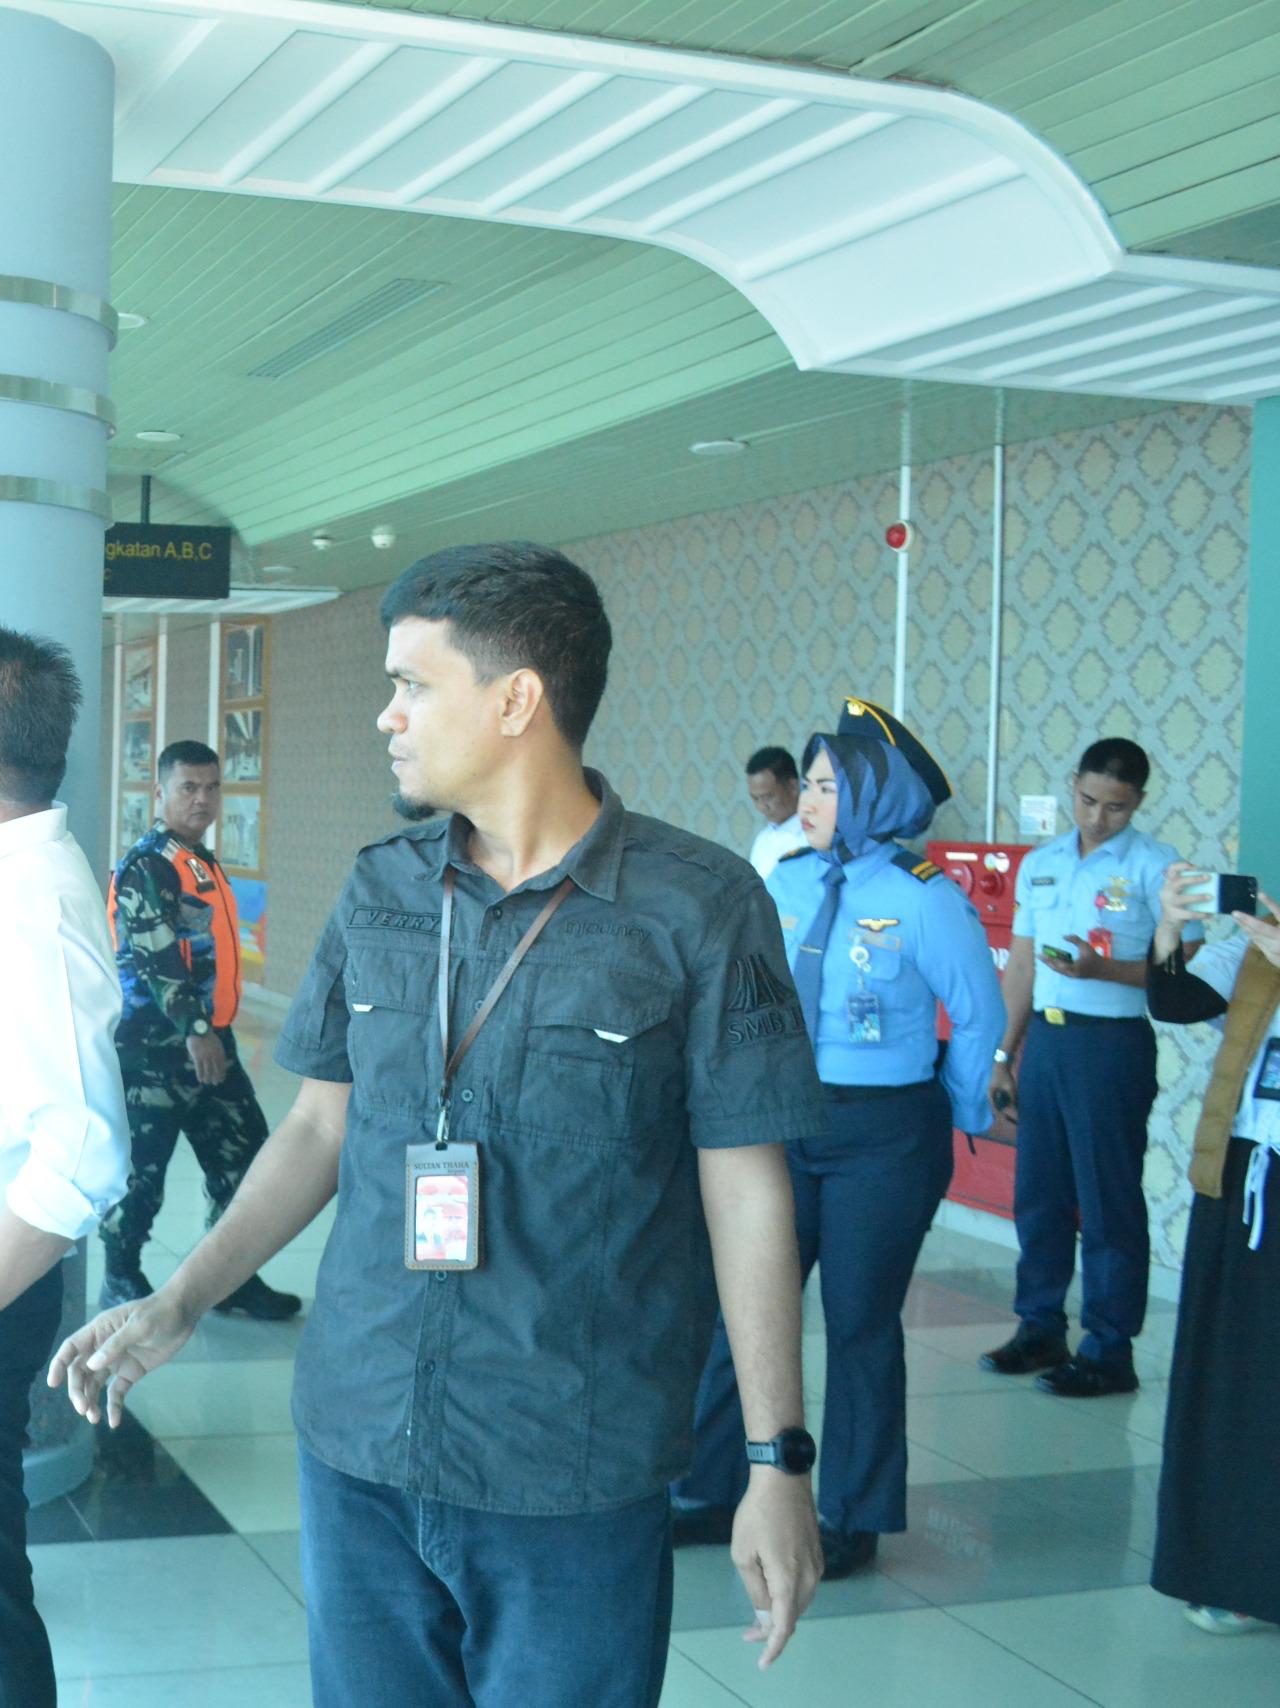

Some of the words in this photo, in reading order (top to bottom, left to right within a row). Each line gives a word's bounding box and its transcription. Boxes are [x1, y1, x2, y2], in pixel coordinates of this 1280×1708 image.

[106, 541, 160, 560] gkatan
[368, 909, 441, 932] VERRY
[727, 1011, 785, 1045] SMB
[414, 1162, 441, 1170] SULTAN
